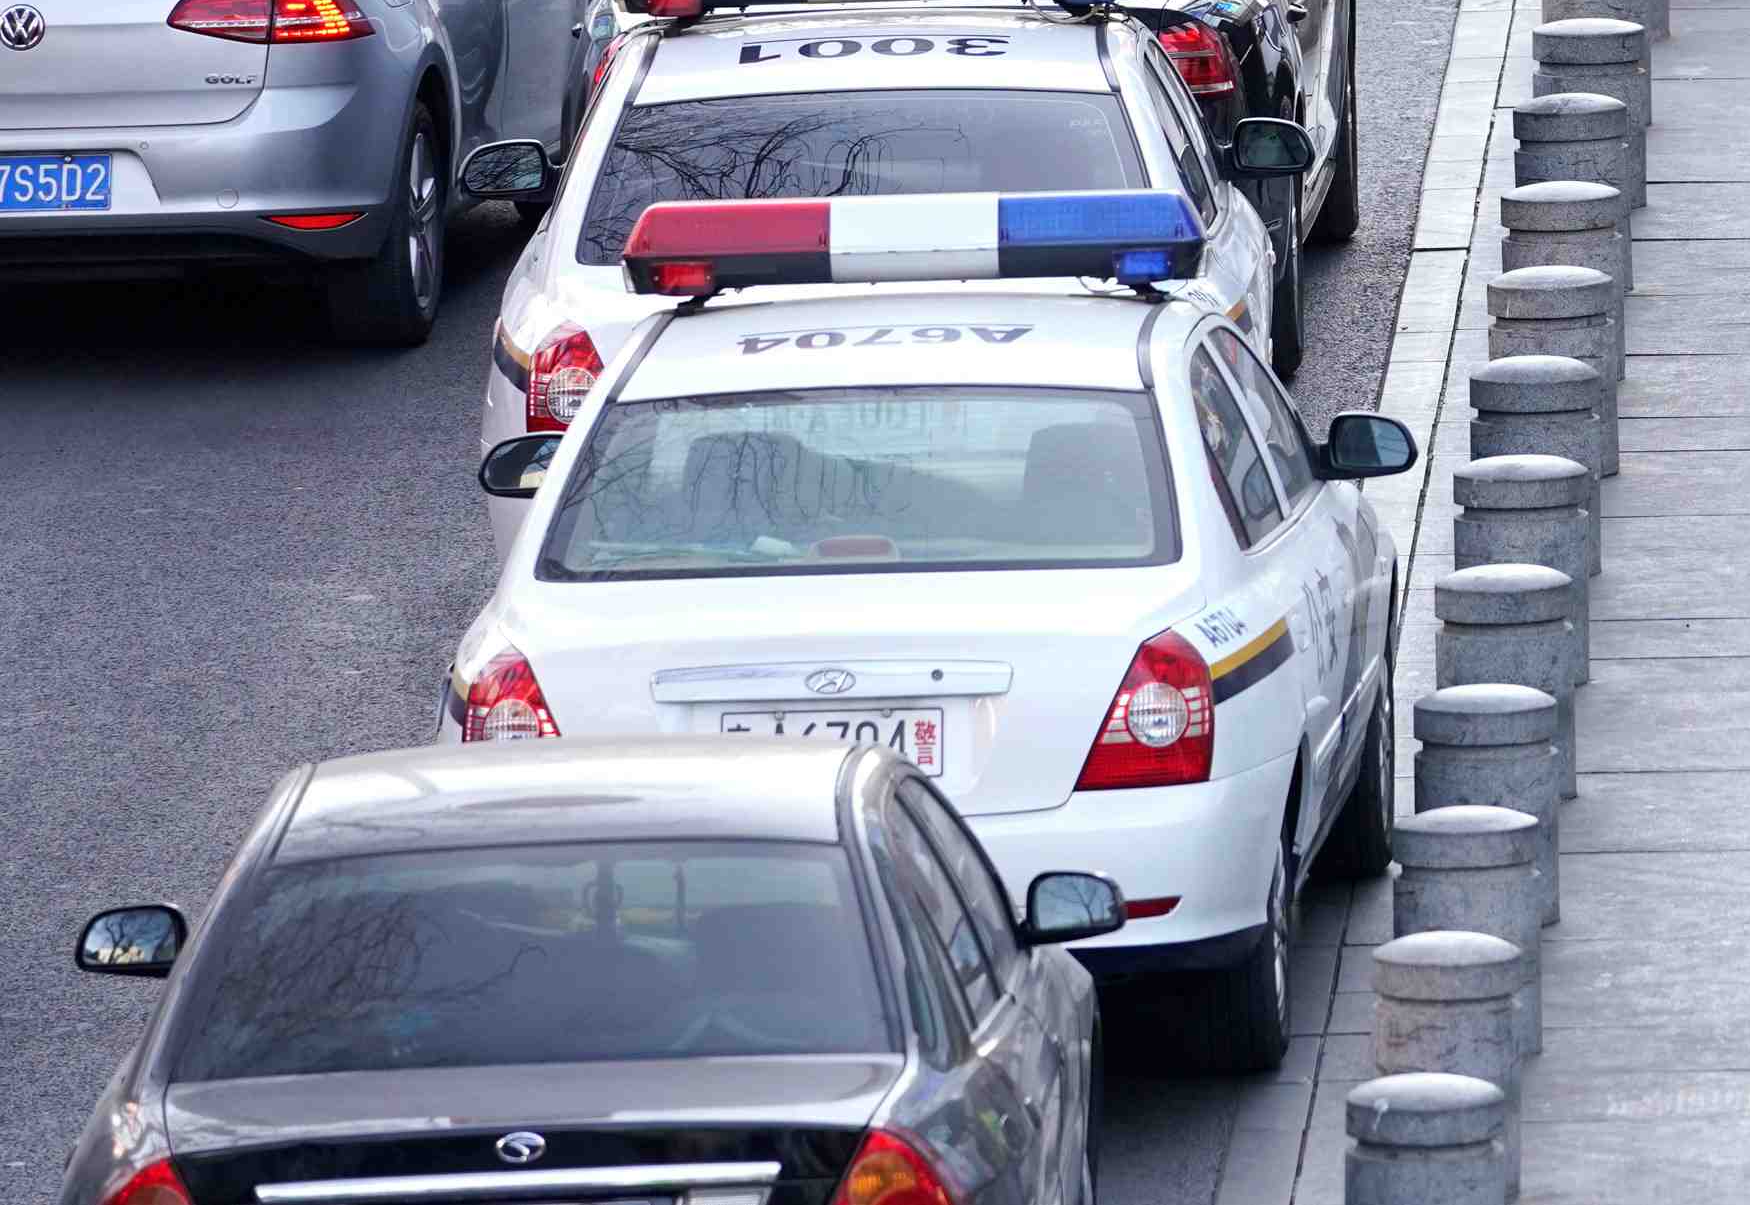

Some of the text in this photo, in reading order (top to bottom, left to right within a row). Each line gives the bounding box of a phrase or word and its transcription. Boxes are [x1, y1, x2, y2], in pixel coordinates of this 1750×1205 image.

[739, 37, 1010, 64] 3001
[204, 75, 257, 86] GOLF
[735, 326, 1034, 356] A6704
